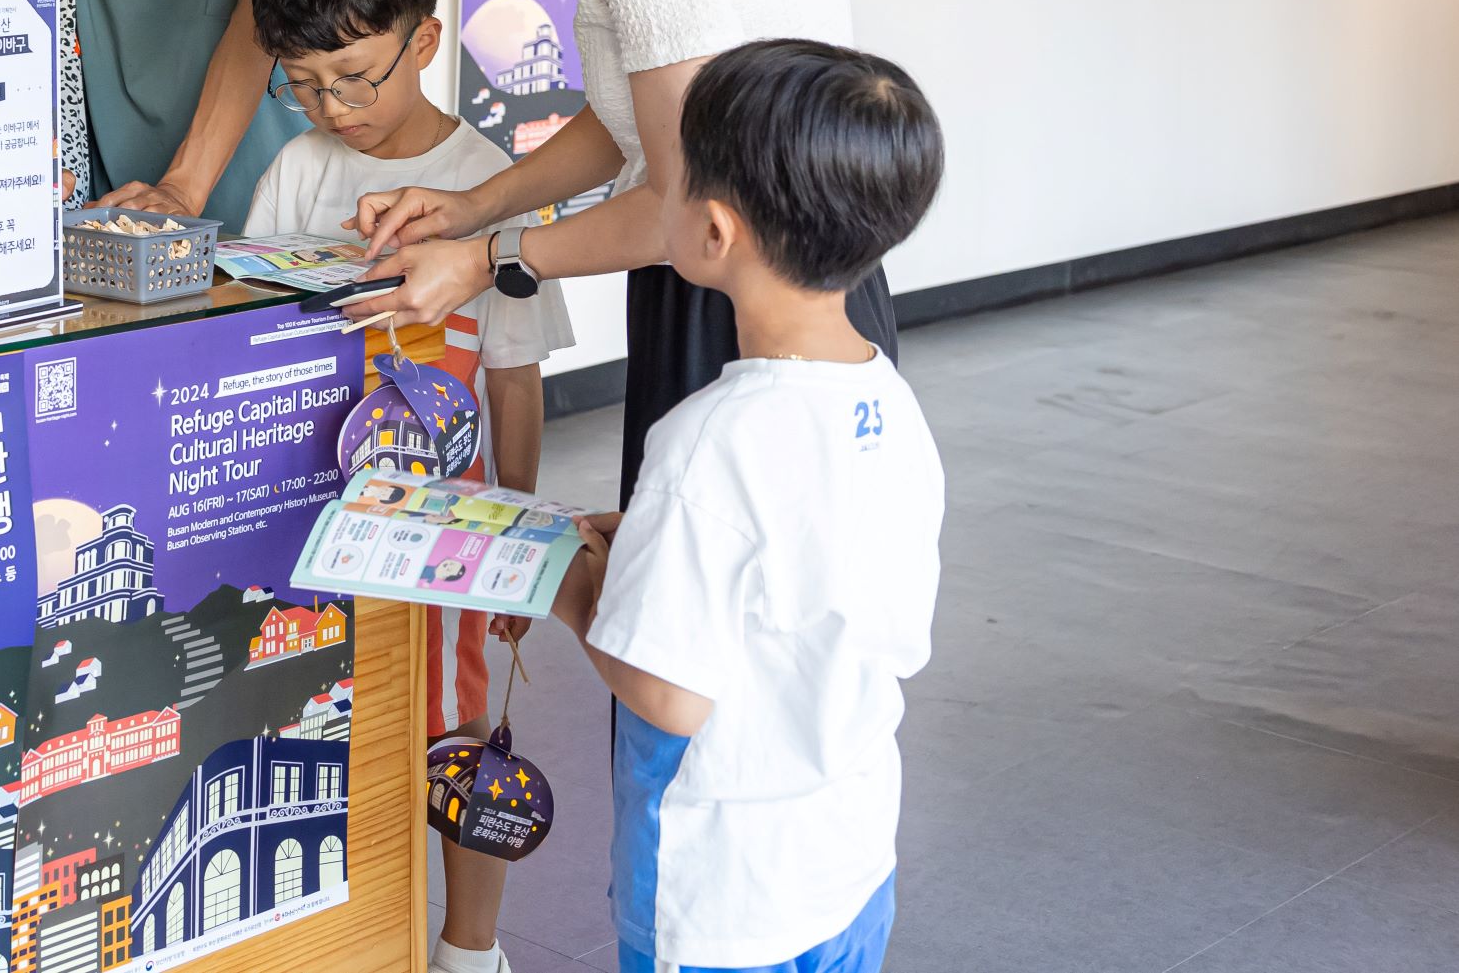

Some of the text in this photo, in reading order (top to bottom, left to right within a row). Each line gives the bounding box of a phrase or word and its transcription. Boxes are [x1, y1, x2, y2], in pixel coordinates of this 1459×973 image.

[7, 219, 15, 232] 꼭
[171, 361, 333, 406] 2024 Refuge, the story of those times
[171, 385, 350, 438] Refuge Capital Busan
[169, 420, 315, 466] Cultural Heritage
[168, 468, 339, 520] AUG 16(FRI) 17(SAT) 17:00 22:00
[169, 458, 263, 496] Night Tour
[167, 490, 339, 538] Busan Modern and Contemporary History Museum,
[167, 518, 268, 552] Busan Observing Station, etc.
[5, 565, 17, 583] 등
[472, 826, 525, 848] 문화유산 야행
[479, 814, 511, 832] 피란수도
[512, 824, 531, 838] 부산
